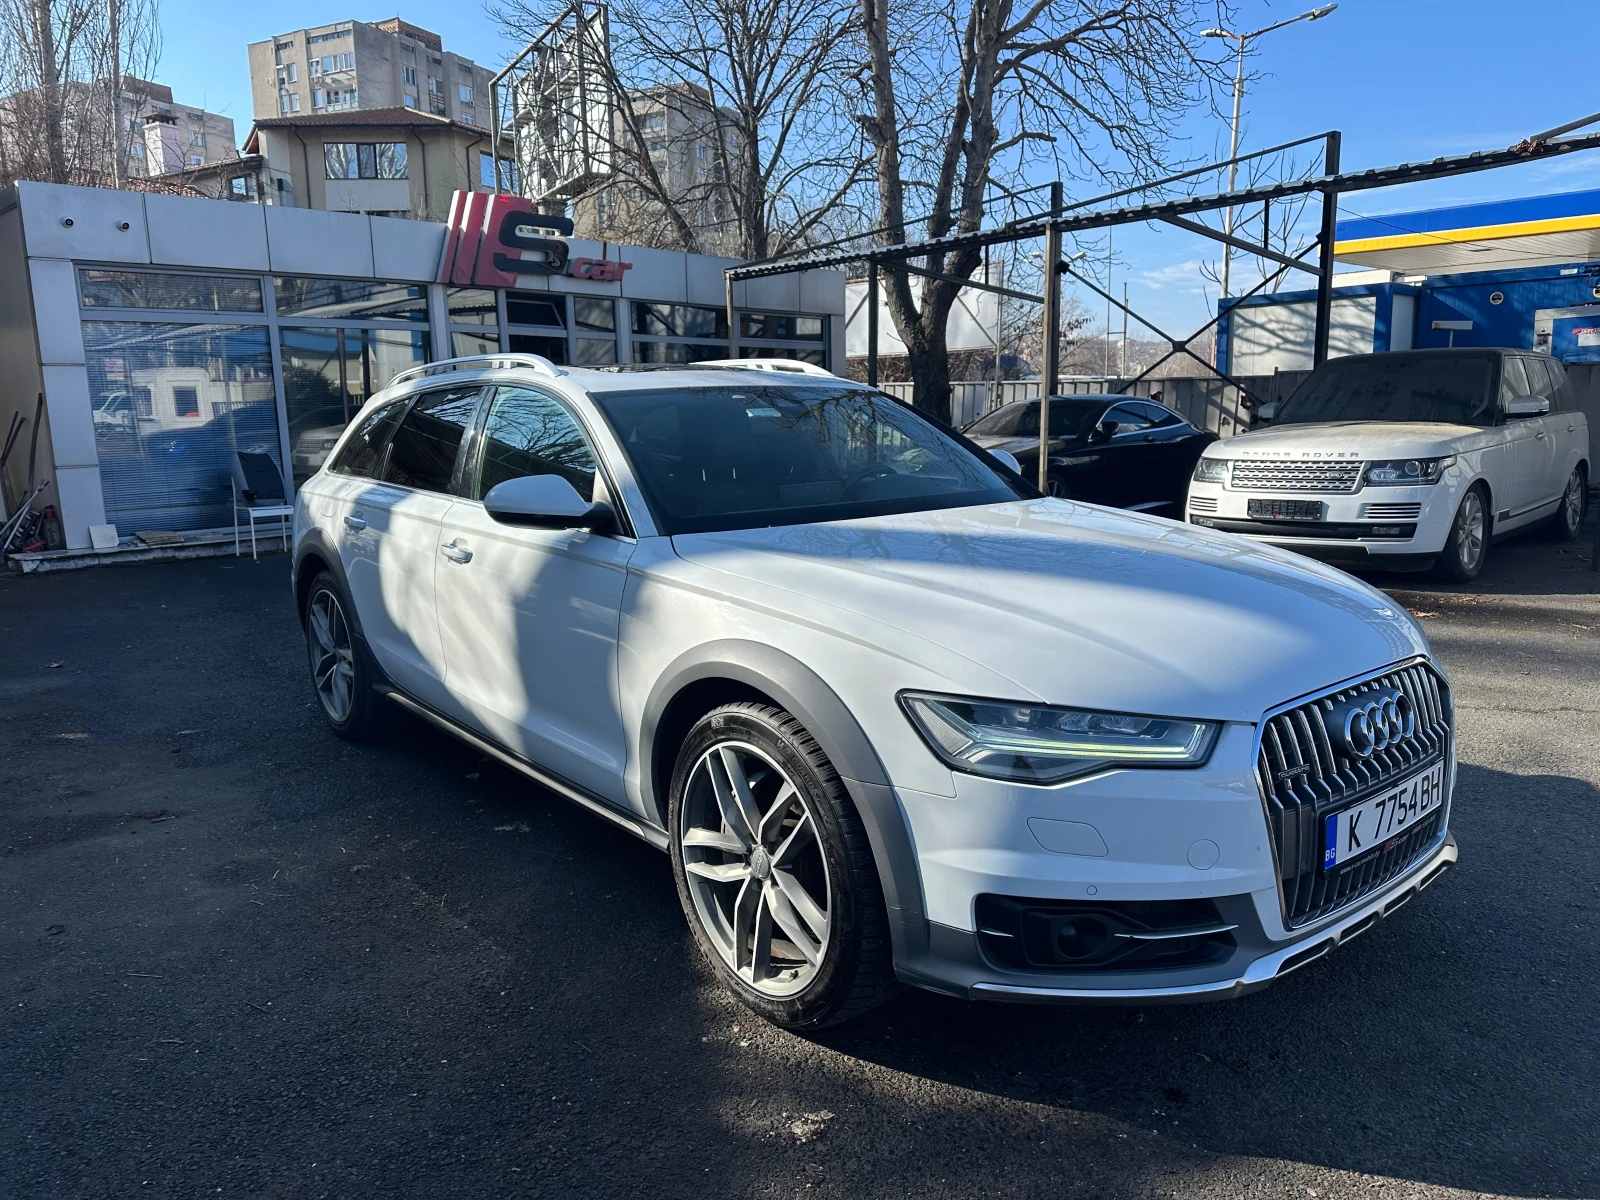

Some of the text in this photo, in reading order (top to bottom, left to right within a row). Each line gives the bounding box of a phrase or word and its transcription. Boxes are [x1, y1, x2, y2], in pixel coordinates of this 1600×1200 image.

[1280, 765, 1310, 778] quattro
[1349, 810, 1362, 852] K
[1325, 848, 1336, 862] BG
